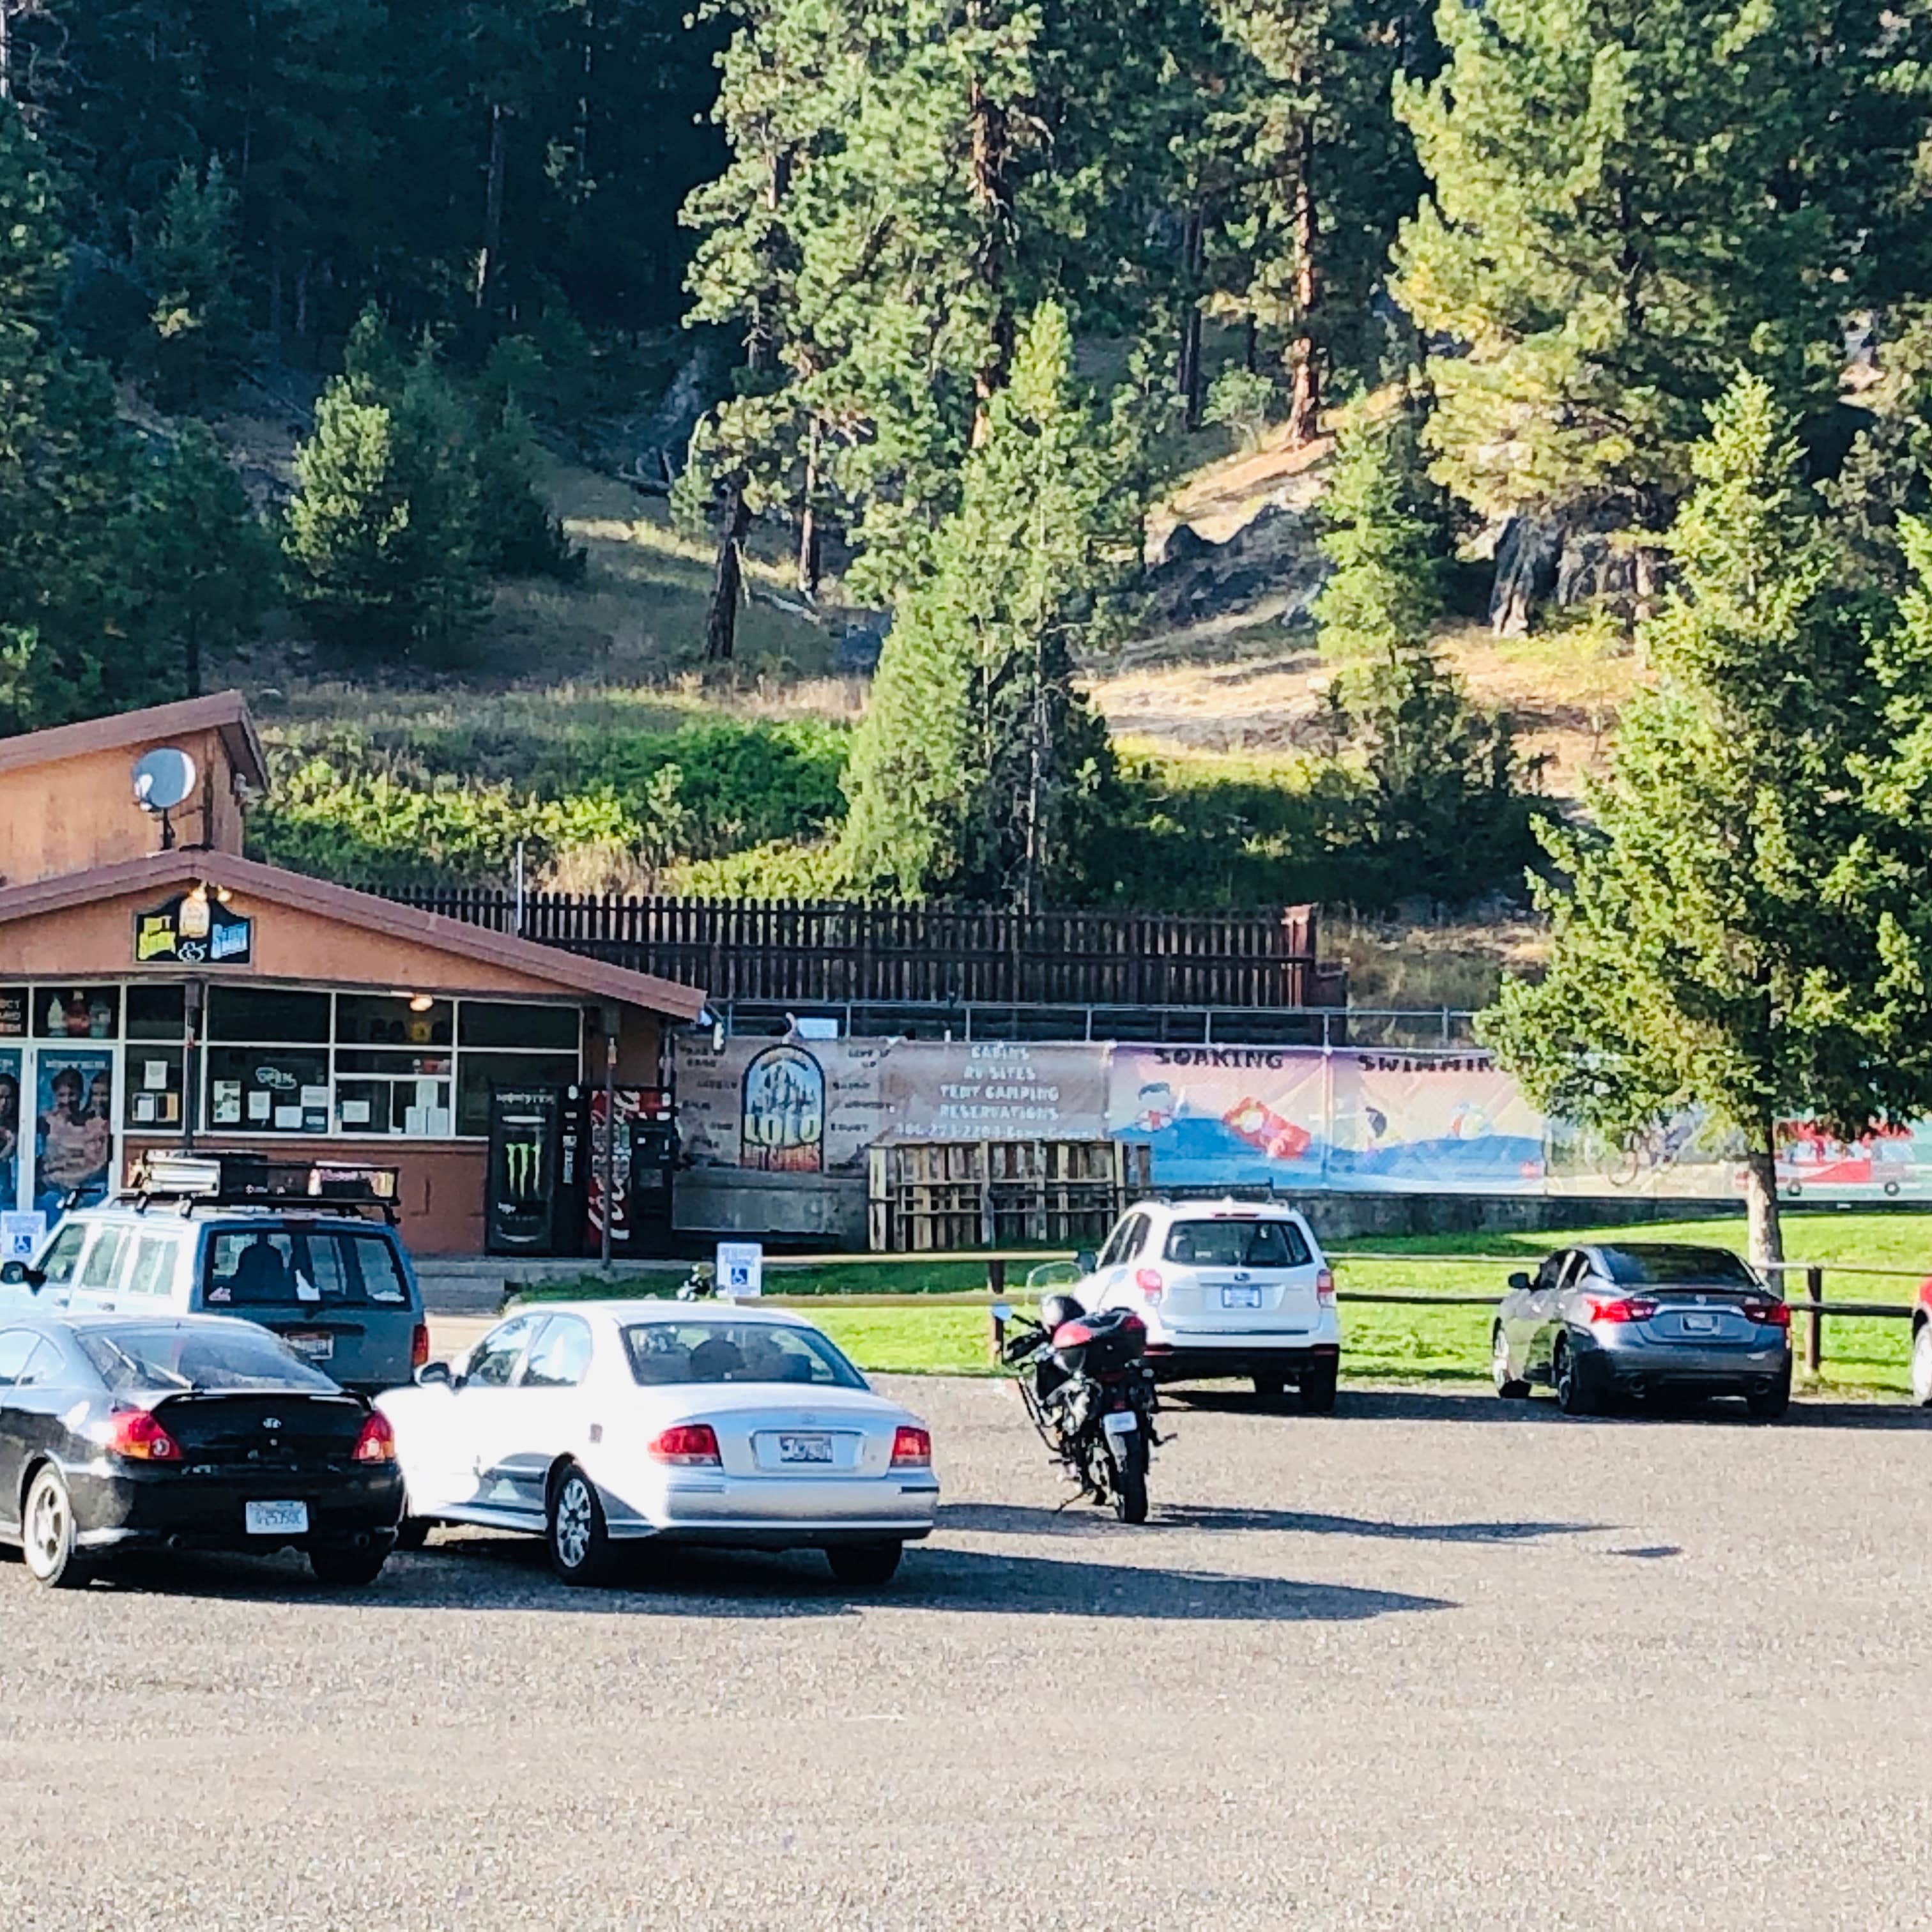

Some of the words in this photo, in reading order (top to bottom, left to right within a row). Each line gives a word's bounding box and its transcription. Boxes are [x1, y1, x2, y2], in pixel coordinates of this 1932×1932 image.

[971, 1046, 1029, 1060] CABINS
[1154, 1048, 1283, 1069] SOAKING
[963, 1066, 983, 1080] RV
[989, 1066, 1036, 1080] SITES
[940, 1084, 981, 1098] TENT
[985, 1086, 1059, 1101] CAMPING
[940, 1104, 1059, 1120] RESERVATIONS
[745, 1114, 822, 1146] LOLO
